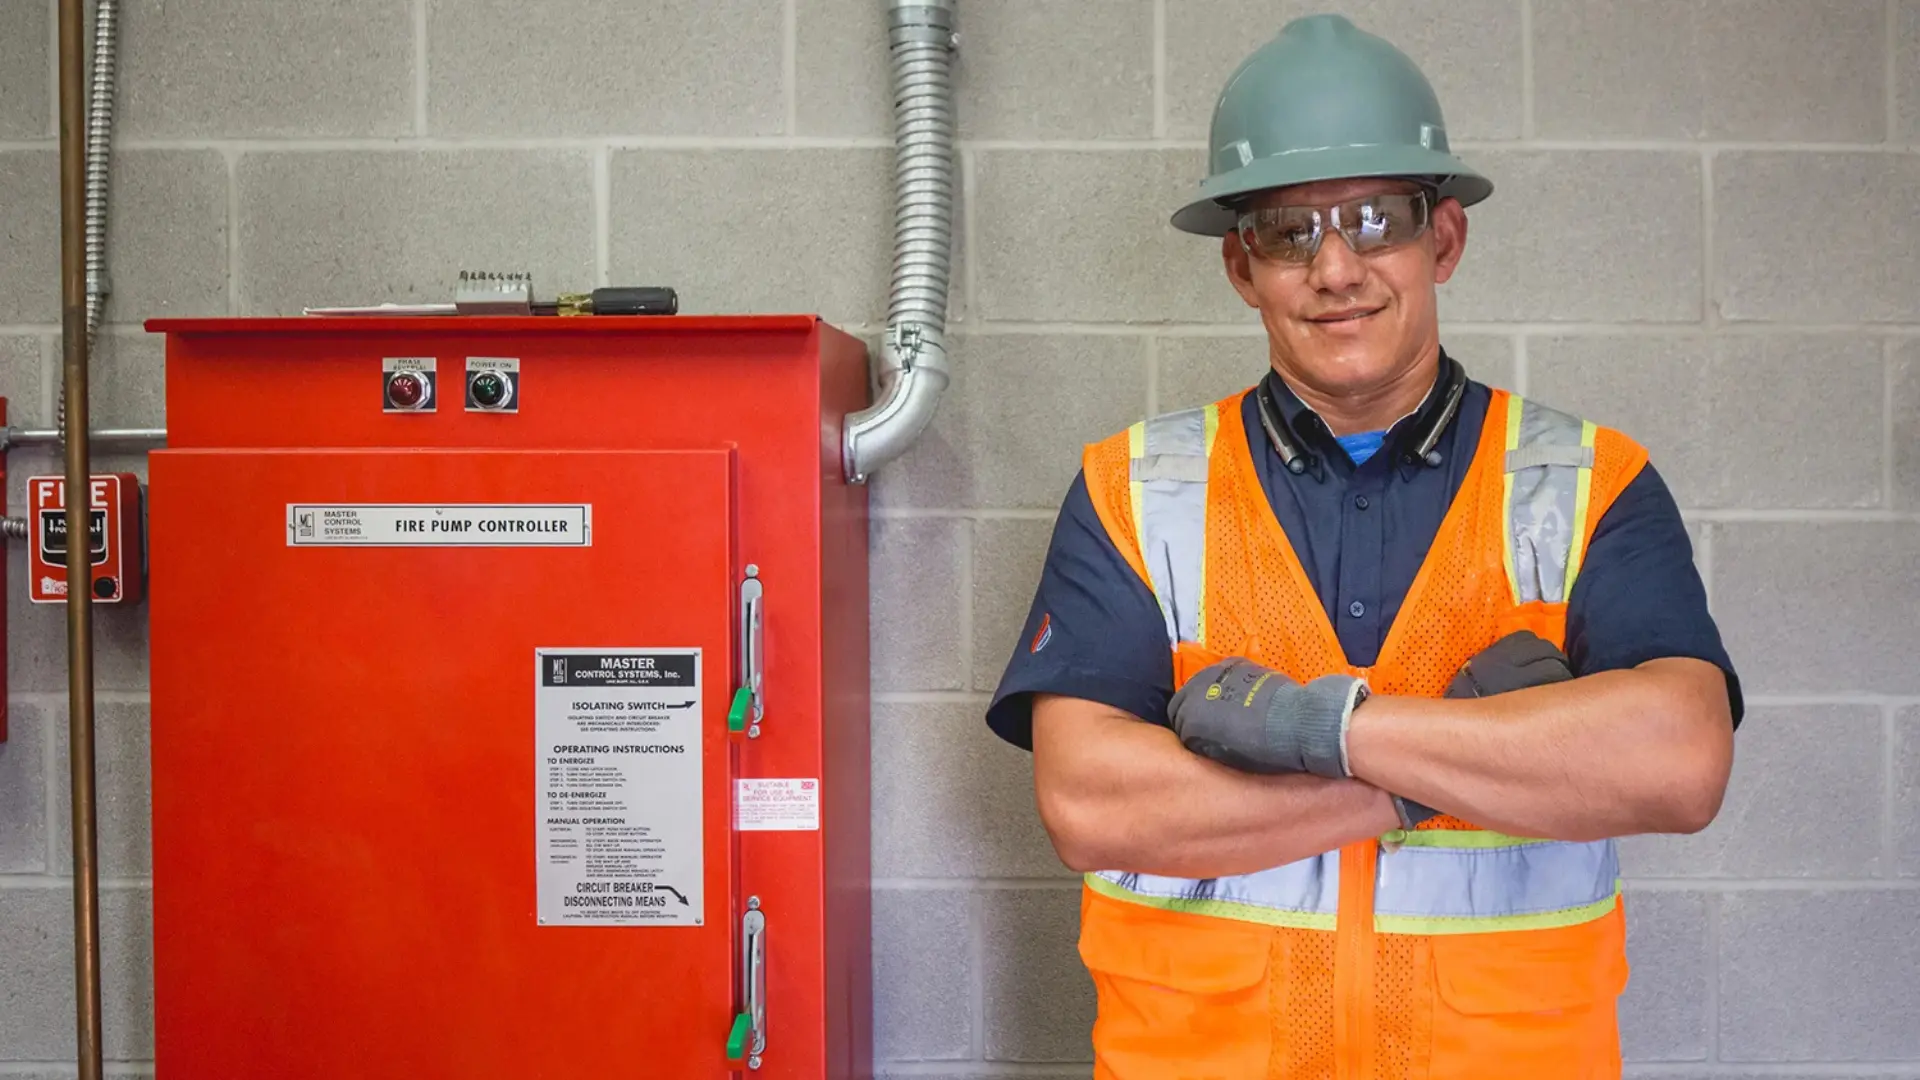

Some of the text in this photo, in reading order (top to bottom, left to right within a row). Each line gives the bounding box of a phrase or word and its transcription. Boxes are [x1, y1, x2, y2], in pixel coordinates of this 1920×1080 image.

[38, 481, 108, 507] FIE
[395, 520, 568, 533] FIRE PUMP CONTROLLER
[600, 658, 655, 669] MASTER
[575, 670, 680, 679] CONTROL SYSTEMS, Inc.
[572, 702, 665, 710] ISOLATING SWITCH
[553, 745, 685, 754] OPERATING INSTRUCTIONS
[576, 882, 653, 893] CIRCUIT BREAKER
[564, 896, 666, 907] DISCONNECTING MEANS
